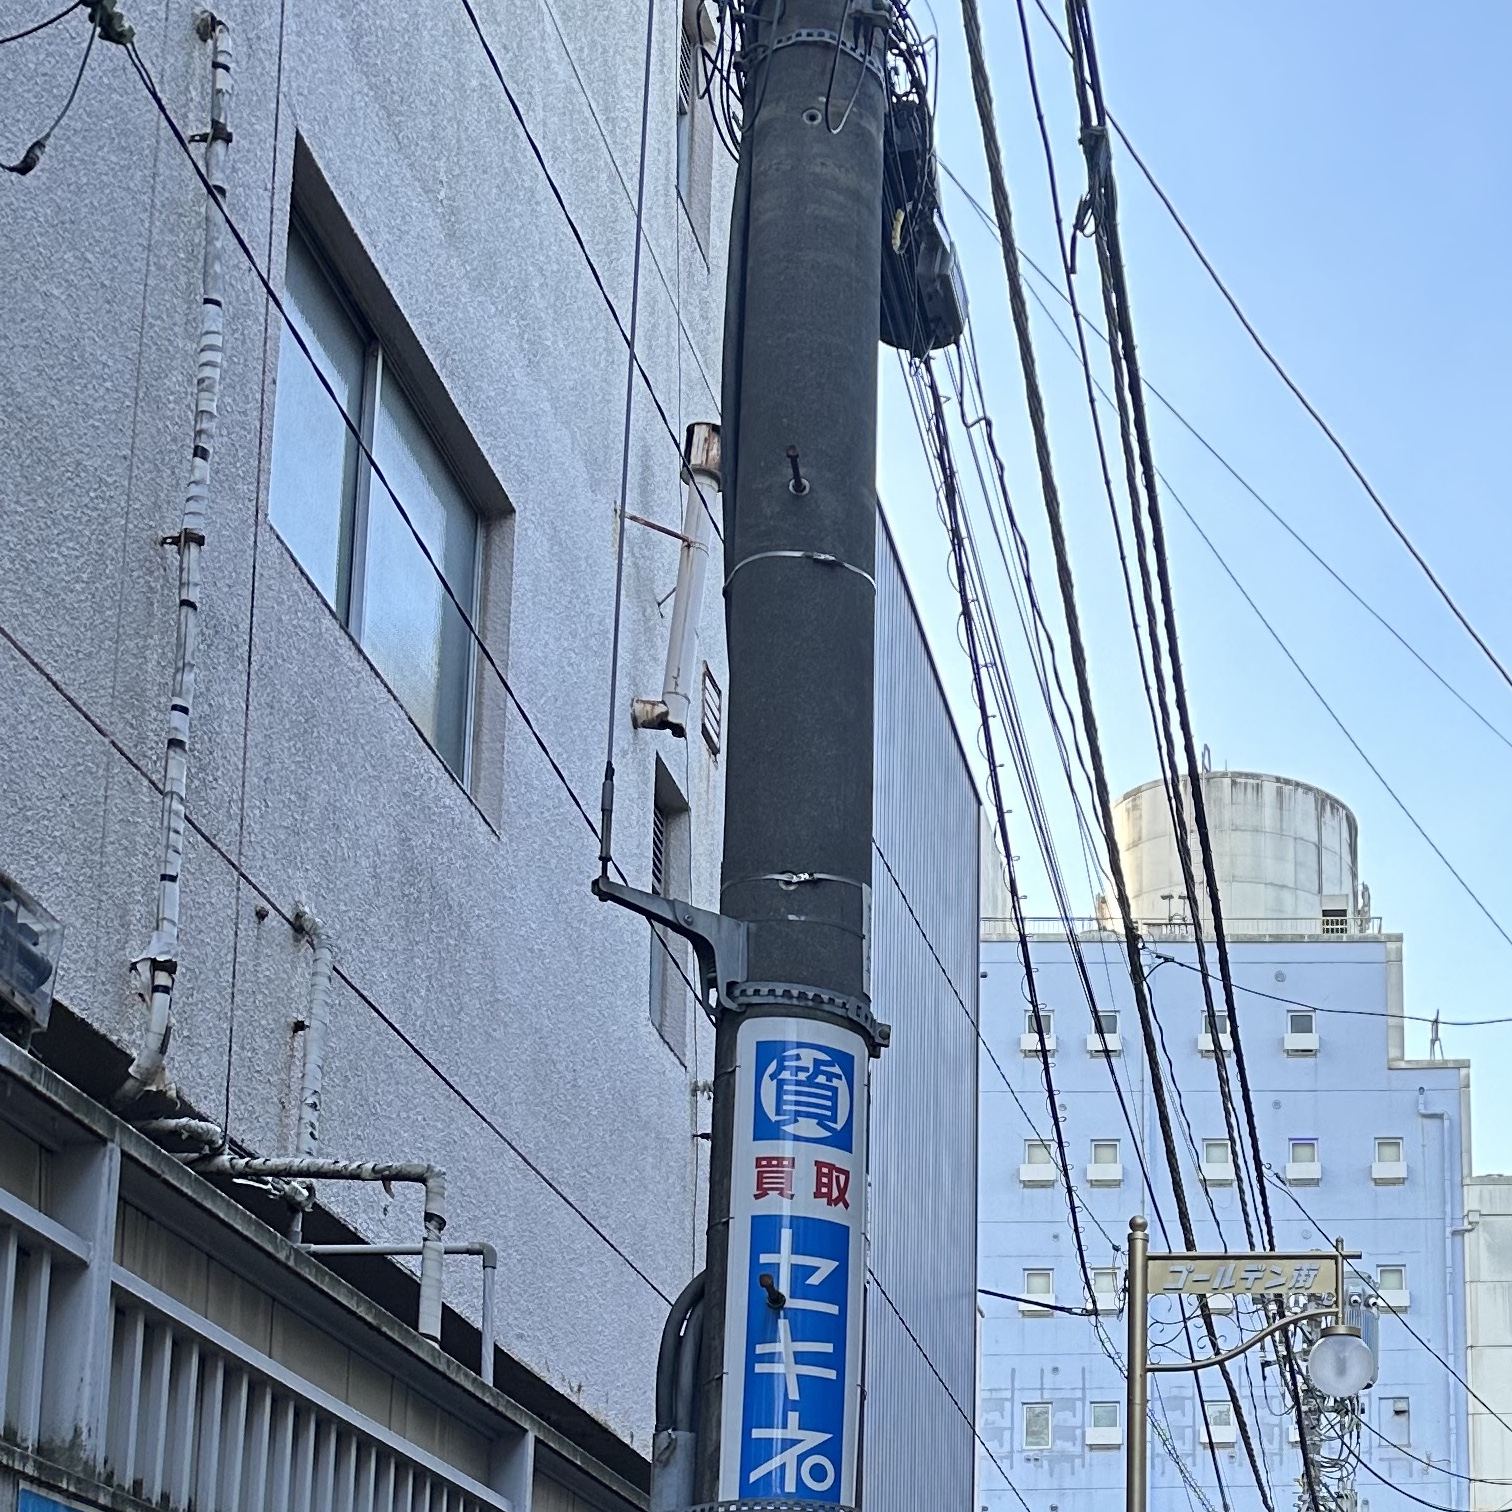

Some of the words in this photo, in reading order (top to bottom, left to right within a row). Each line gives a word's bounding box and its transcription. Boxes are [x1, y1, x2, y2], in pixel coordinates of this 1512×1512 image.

[768, 1053, 843, 1135] 質
[753, 1156, 850, 1211] 買取
[1163, 1263, 1320, 1290] ゴールデン街
[749, 1228, 840, 1493] セキネ
